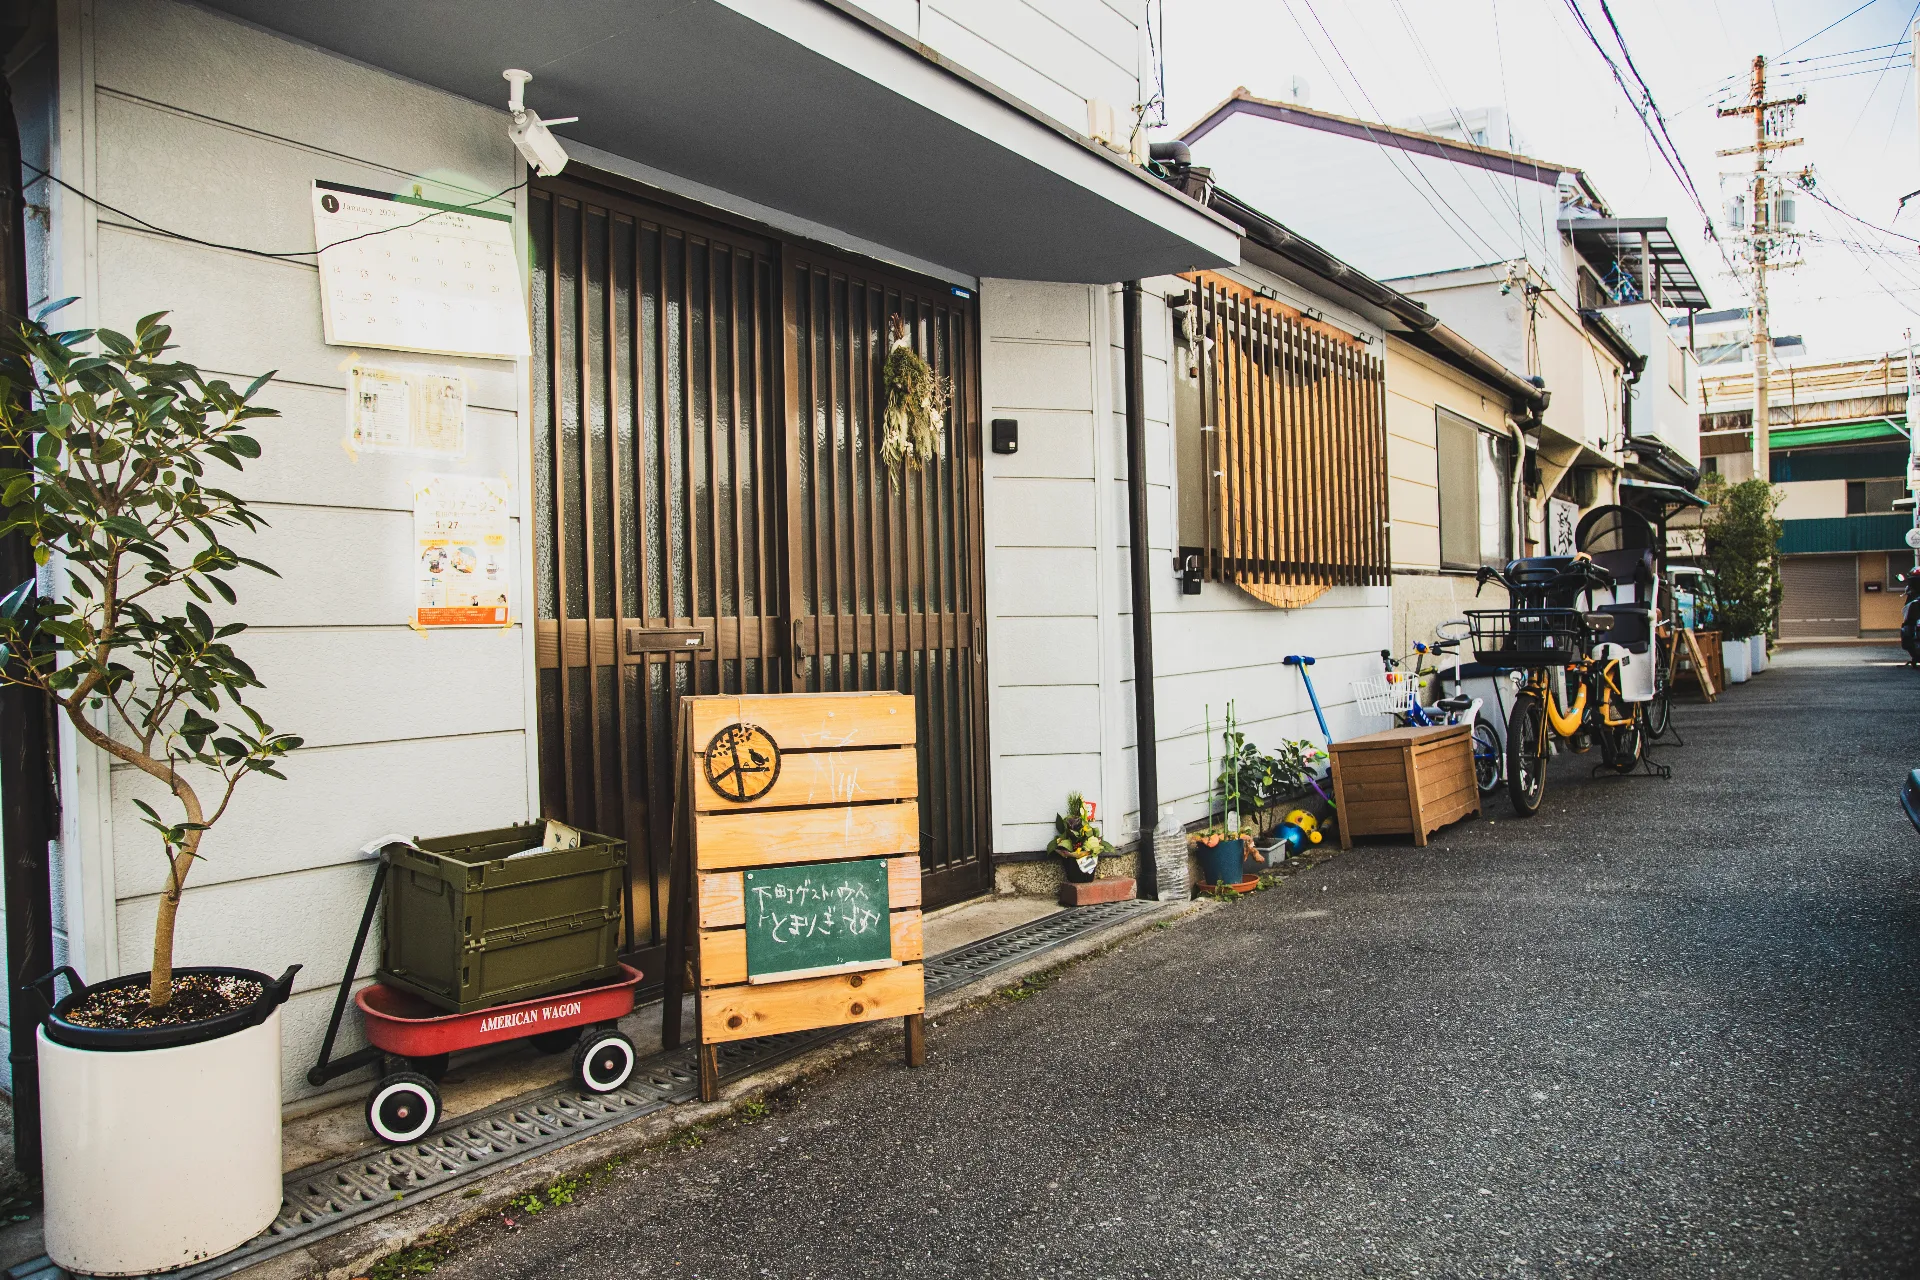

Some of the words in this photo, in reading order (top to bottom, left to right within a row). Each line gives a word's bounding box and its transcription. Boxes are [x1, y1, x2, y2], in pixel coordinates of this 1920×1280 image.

[328, 198, 333, 208] 1
[342, 202, 374, 216] January
[438, 500, 497, 512] マリアージュ
[479, 1010, 538, 1032] AMERICAN
[542, 1001, 581, 1020] WAGON
